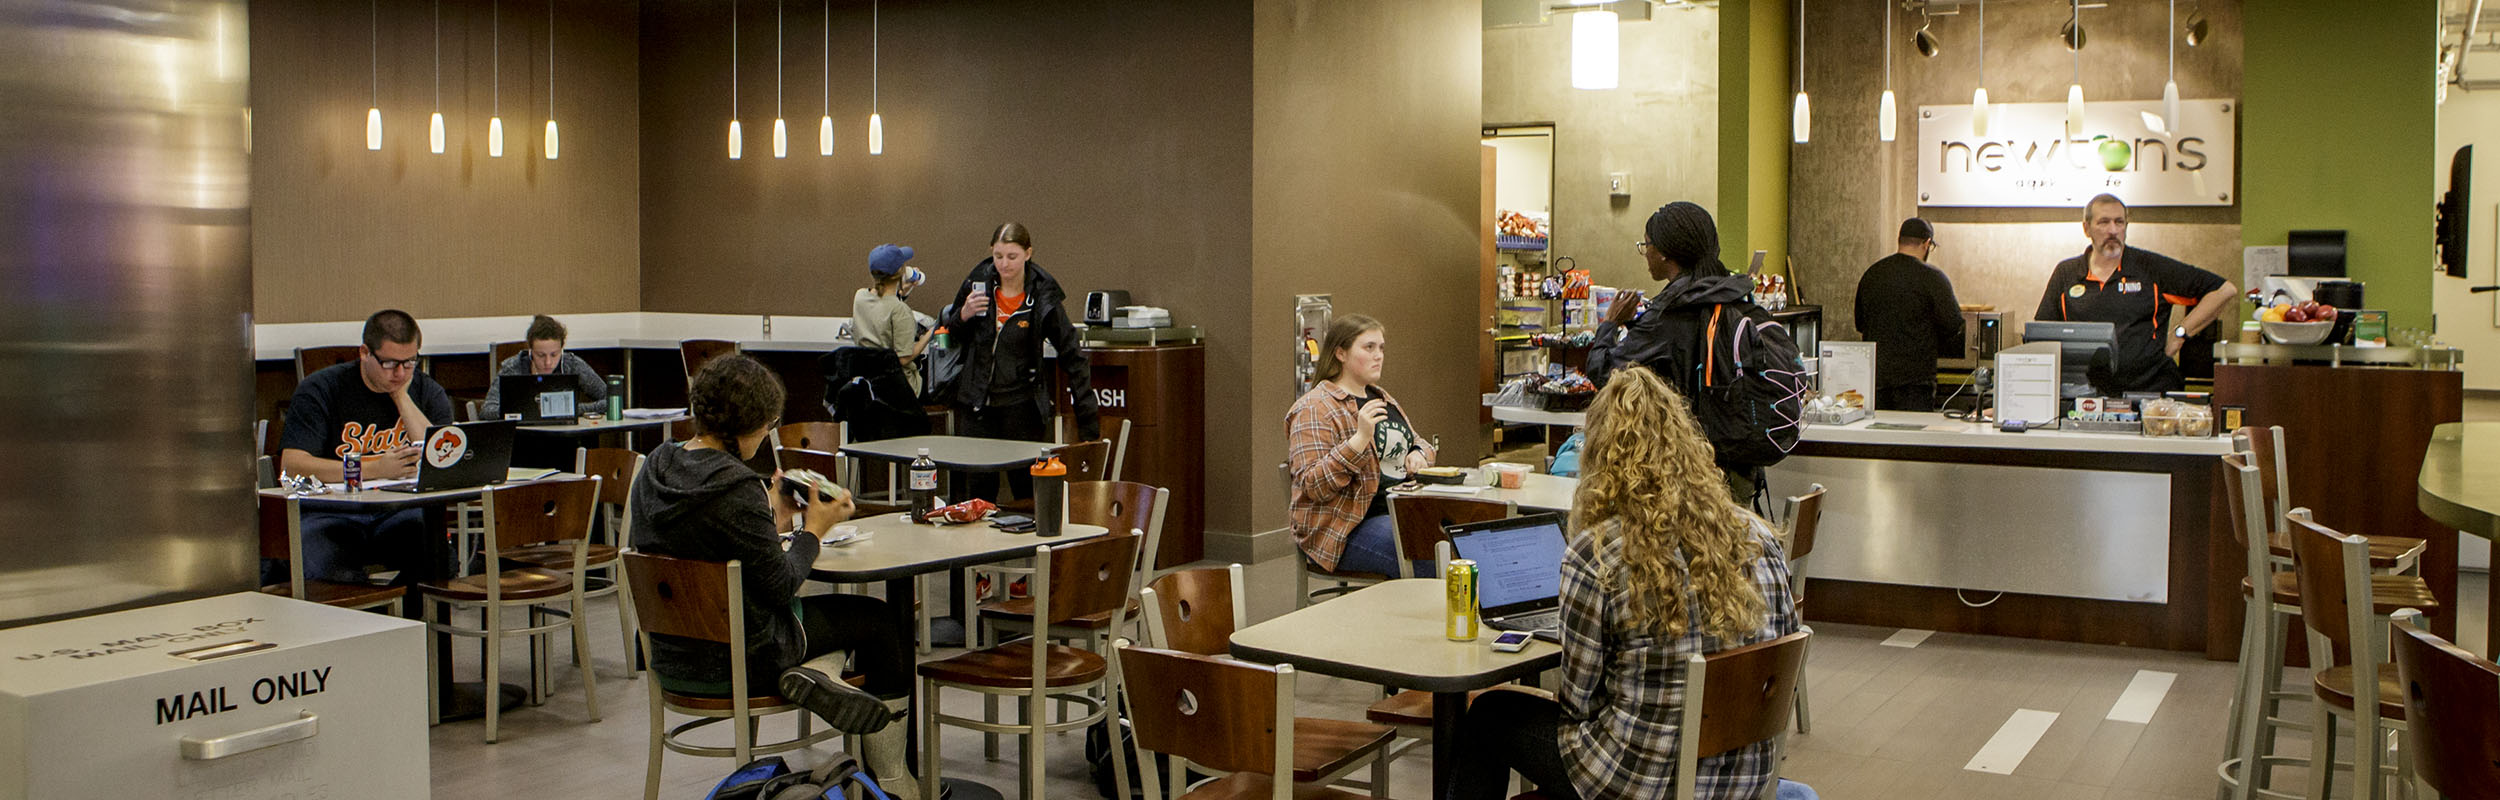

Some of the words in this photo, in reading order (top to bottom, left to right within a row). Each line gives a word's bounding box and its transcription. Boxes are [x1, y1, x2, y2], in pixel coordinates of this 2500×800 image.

[335, 416, 411, 458] Stat
[69, 644, 160, 660] MAIL
[168, 626, 248, 643] ONLY
[101, 632, 187, 647] MAIL
[192, 617, 265, 632] BOX
[156, 686, 239, 726] MAIL
[252, 666, 333, 706] ONLY
